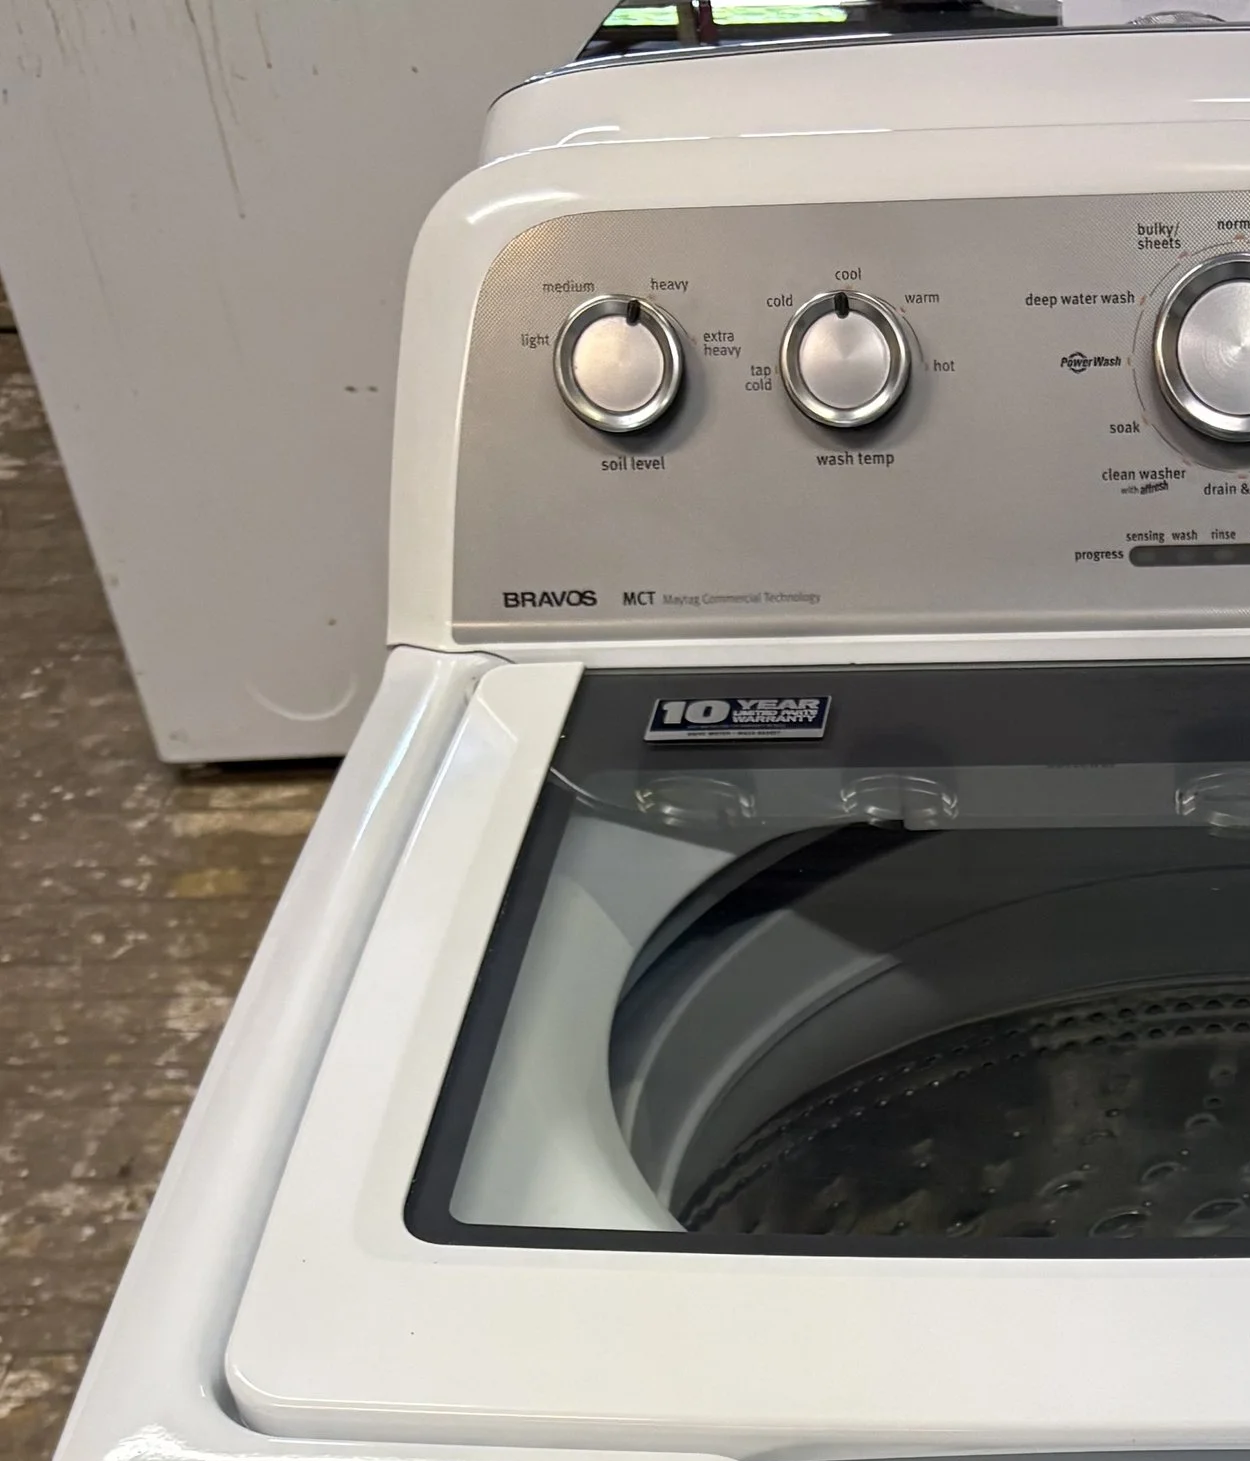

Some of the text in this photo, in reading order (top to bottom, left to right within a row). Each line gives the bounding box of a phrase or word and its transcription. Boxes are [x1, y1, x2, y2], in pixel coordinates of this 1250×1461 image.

[1136, 222, 1180, 239] bulky/
[1137, 236, 1182, 250] sheets
[834, 267, 862, 281] cool
[542, 279, 596, 294] medium
[650, 277, 690, 292] heavy
[766, 294, 794, 308] cold
[904, 291, 940, 304] warm
[1025, 290, 1136, 309] deep water wash
[521, 333, 551, 348] light
[703, 330, 735, 343] extra
[703, 344, 742, 358] heavy
[750, 364, 772, 380] tap
[933, 359, 956, 373] hot
[745, 377, 773, 391] cold
[1109, 421, 1140, 434] soak
[601, 455, 666, 471] soil level
[816, 452, 895, 467] wash temp
[1101, 466, 1186, 481] clean washer
[1203, 483, 1237, 496] drain
[1240, 483, 1250, 495] &
[1126, 530, 1165, 544] sensing
[1171, 527, 1198, 541] wash
[1211, 526, 1236, 540] rinse
[1074, 548, 1125, 561] progress
[503, 590, 598, 608] BRAVOS
[623, 592, 656, 606] MCT
[737, 699, 820, 709] YEAR
[662, 700, 731, 724] 10
[732, 714, 817, 723] WARRANTY
